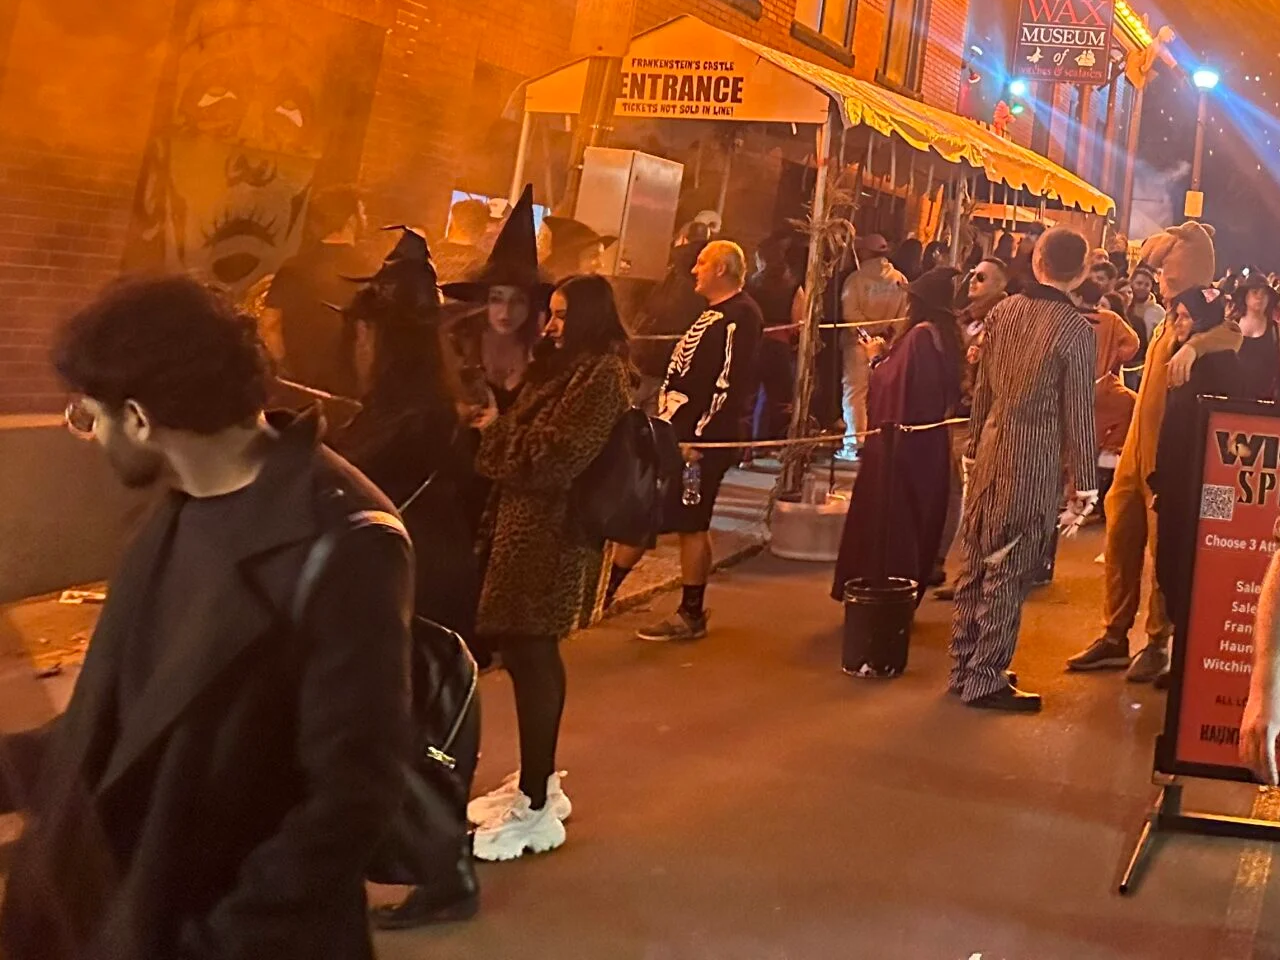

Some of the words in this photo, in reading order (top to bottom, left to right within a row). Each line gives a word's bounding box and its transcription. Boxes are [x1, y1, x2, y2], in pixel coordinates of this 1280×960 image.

[1020, 26, 1106, 46] MUSEUM
[1053, 48, 1070, 66] of
[631, 58, 700, 70] FRANKENSTEIN'S
[703, 61, 734, 71] CASTLE
[620, 72, 744, 103] ENTRANCE
[622, 102, 658, 113] TICKETS
[660, 103, 677, 114] NOT
[680, 104, 699, 114] SOLD
[702, 106, 711, 115] IN
[713, 106, 734, 116] LINE!
[1205, 534, 1247, 549] Choose
[1249, 539, 1257, 550] 3
[1236, 581, 1261, 594] Sale
[1231, 601, 1258, 614] Sale
[1224, 620, 1252, 633] Fran
[1220, 640, 1253, 654] Haun
[1203, 658, 1251, 673] Witchin
